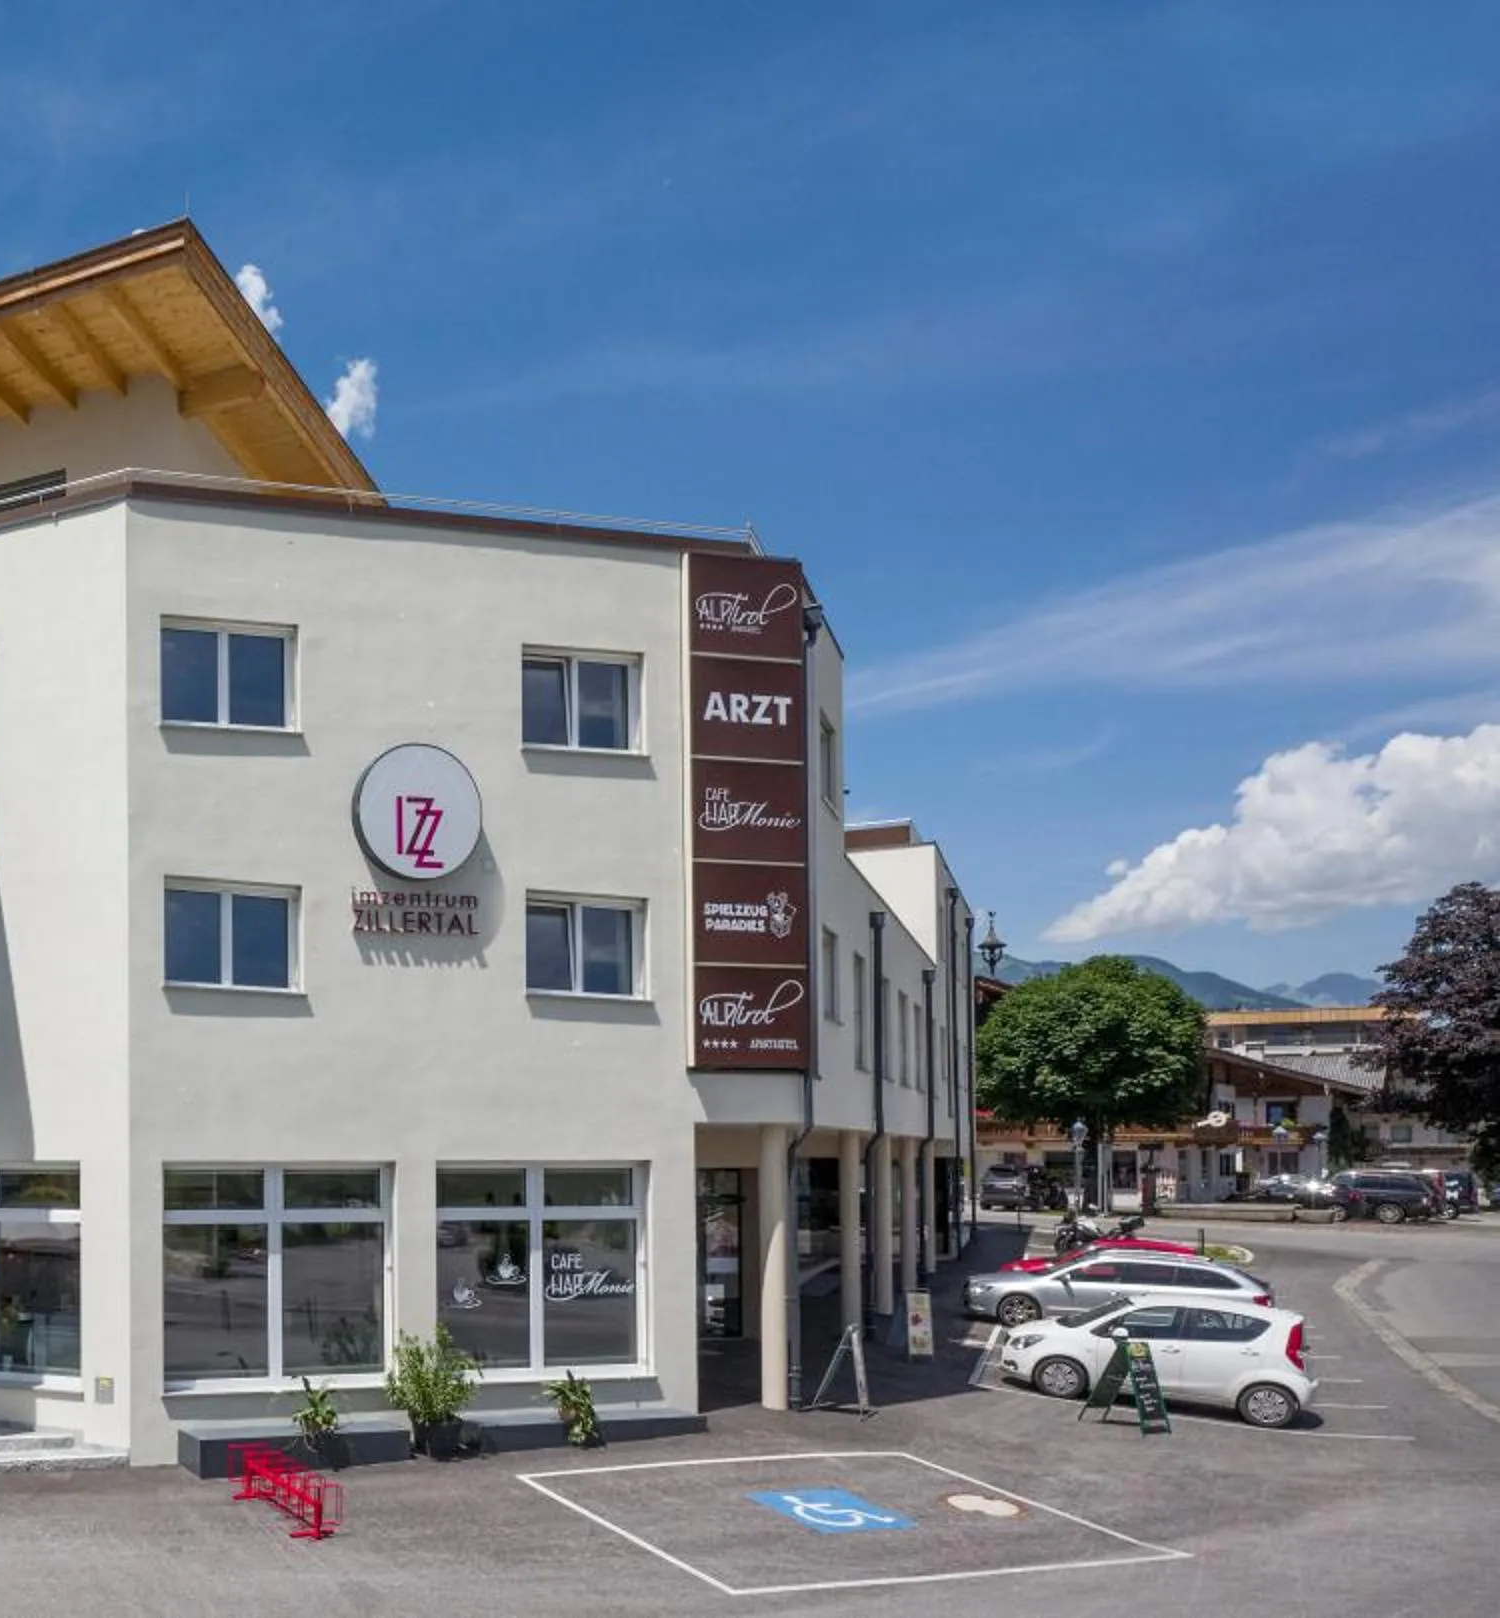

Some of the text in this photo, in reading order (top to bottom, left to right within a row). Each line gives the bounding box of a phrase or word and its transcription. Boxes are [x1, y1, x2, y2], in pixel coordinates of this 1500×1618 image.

[703, 691, 793, 727] ARZT
[353, 908, 481, 936] ZILLERTAL
[705, 917, 766, 933] PARADIES
